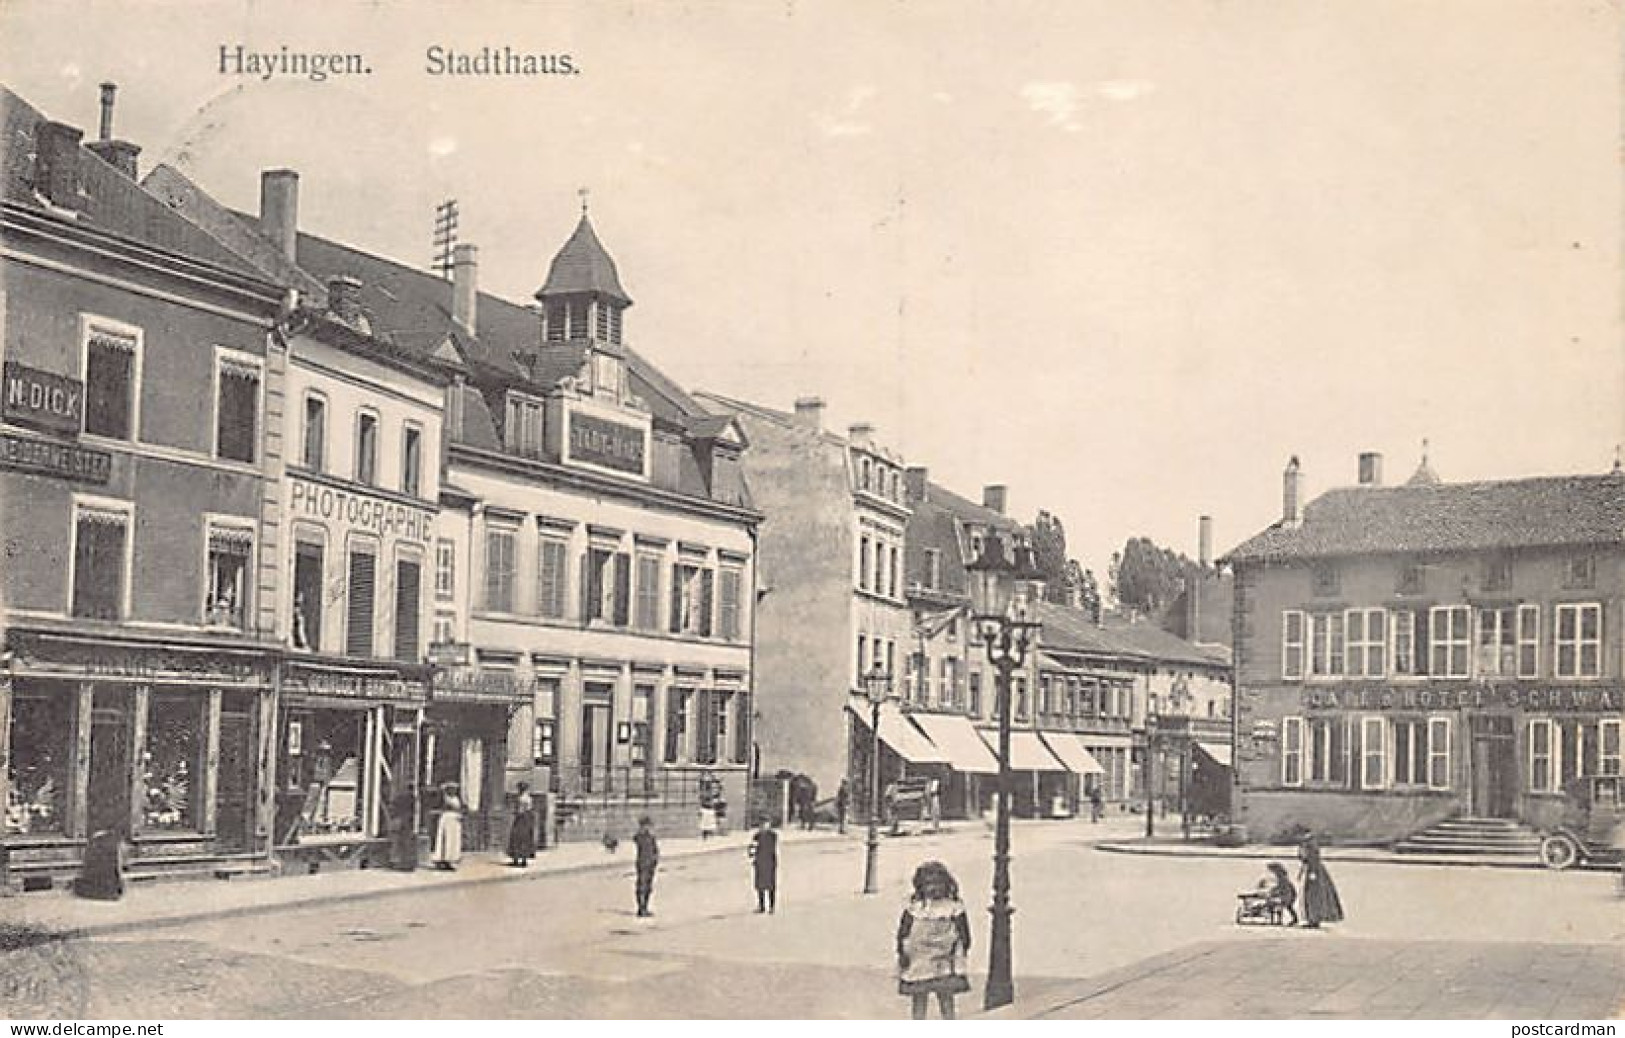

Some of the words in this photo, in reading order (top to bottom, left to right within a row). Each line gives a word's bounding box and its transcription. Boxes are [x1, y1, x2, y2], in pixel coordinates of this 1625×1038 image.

[31, 383, 79, 419] DICK
[290, 482, 431, 541] PHOTOGRAPHIE
[1405, 690, 1482, 707] HOTEL
